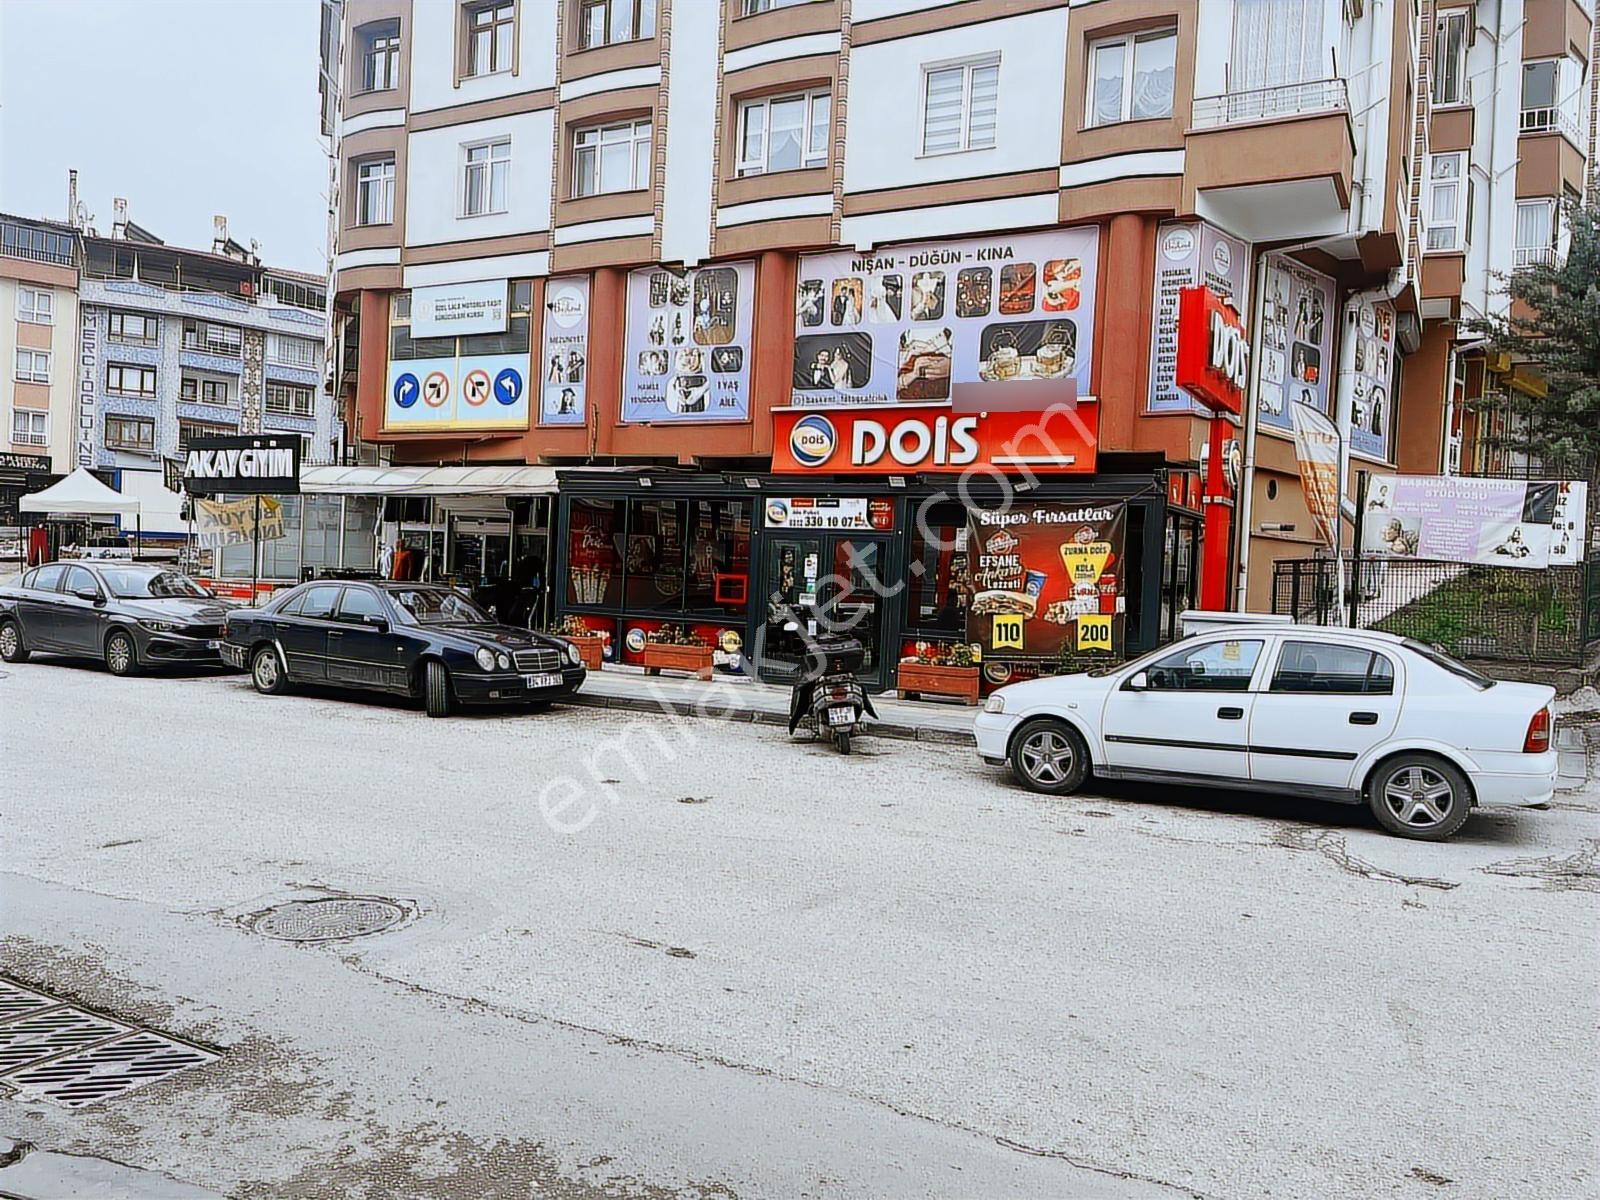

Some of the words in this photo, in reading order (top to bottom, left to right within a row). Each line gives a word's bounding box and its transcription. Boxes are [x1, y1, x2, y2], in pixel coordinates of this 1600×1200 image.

[909, 250, 961, 268] DÜĞÜN
[976, 246, 1014, 261] KINA
[722, 381, 739, 392] YAŞ
[805, 516, 823, 527] 330
[827, 517, 838, 527] 10
[841, 517, 853, 528] 07
[980, 511, 1030, 528] Süper
[1032, 507, 1114, 524] Fırsatlar
[1064, 546, 1088, 556] ZURNA
[979, 555, 1020, 568] EFSANE
[995, 622, 1020, 642] 110
[1080, 624, 1109, 642] 200
